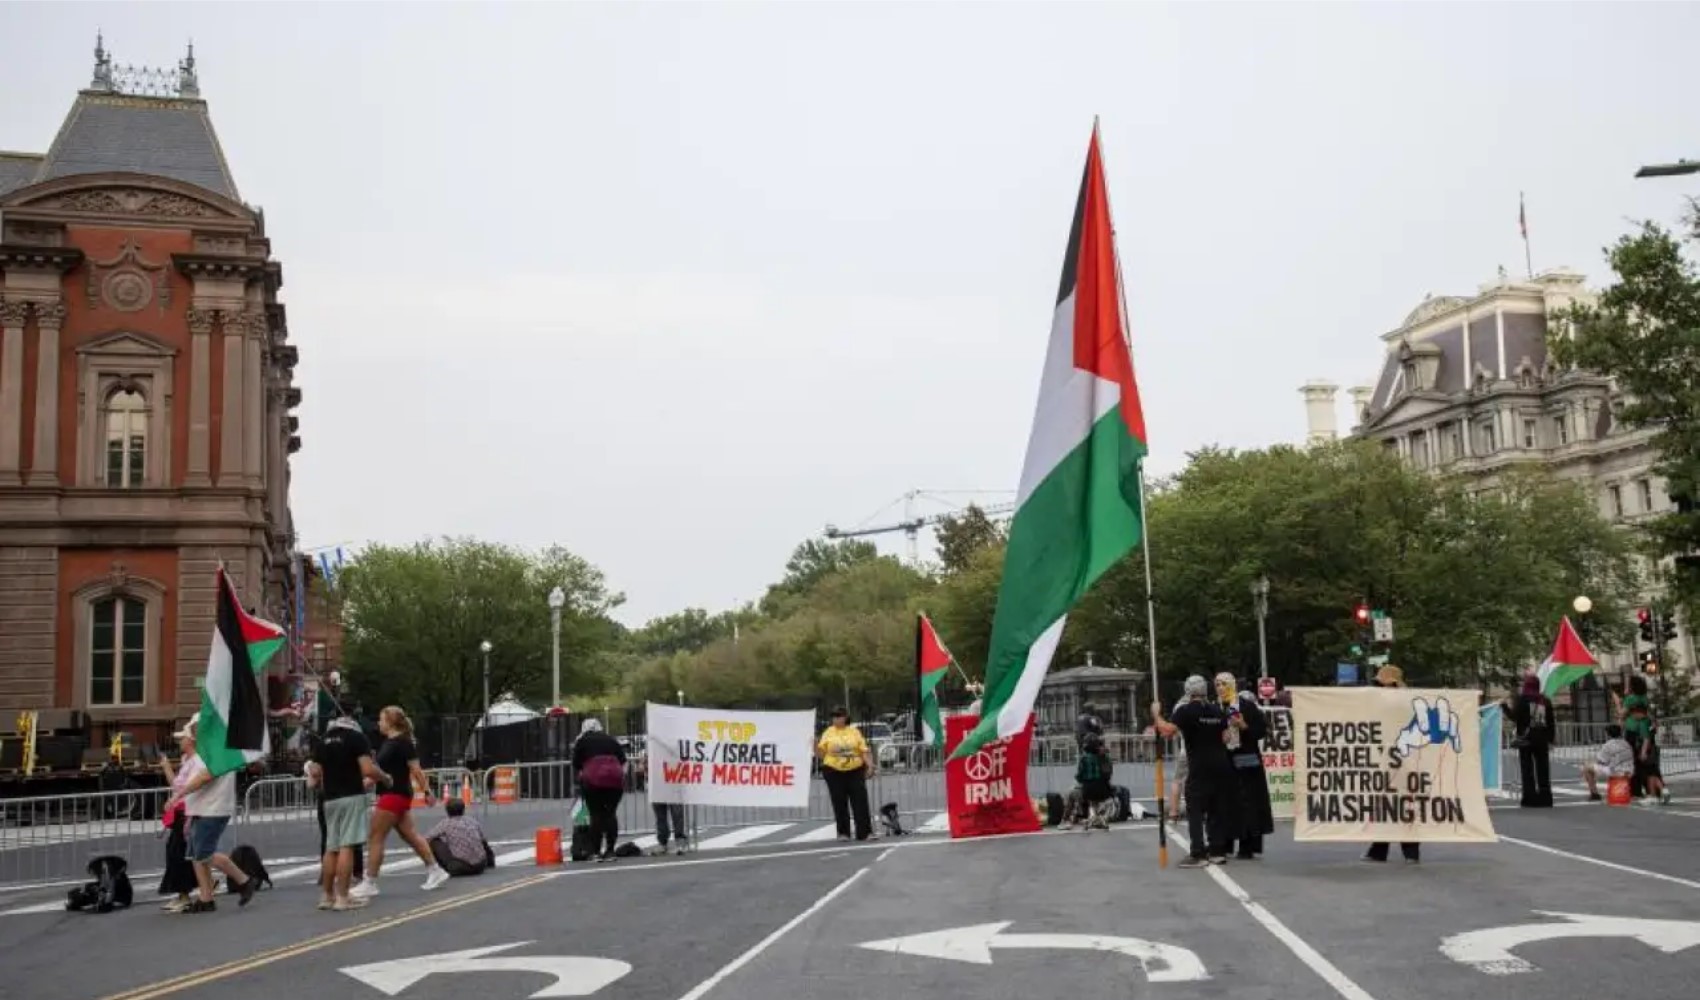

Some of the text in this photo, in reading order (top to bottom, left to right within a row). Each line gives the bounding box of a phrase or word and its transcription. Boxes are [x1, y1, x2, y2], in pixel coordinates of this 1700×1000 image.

[697, 720, 757, 742] STOP
[1306, 721, 1382, 745] EXPOSE
[1306, 746, 1402, 769] ISRAEL'S
[663, 762, 795, 786] WAR MACHINE
[1306, 771, 1432, 794] CONTROL OF
[965, 777, 1013, 805] IRAN
[1306, 794, 1465, 823] WASHINGTON
